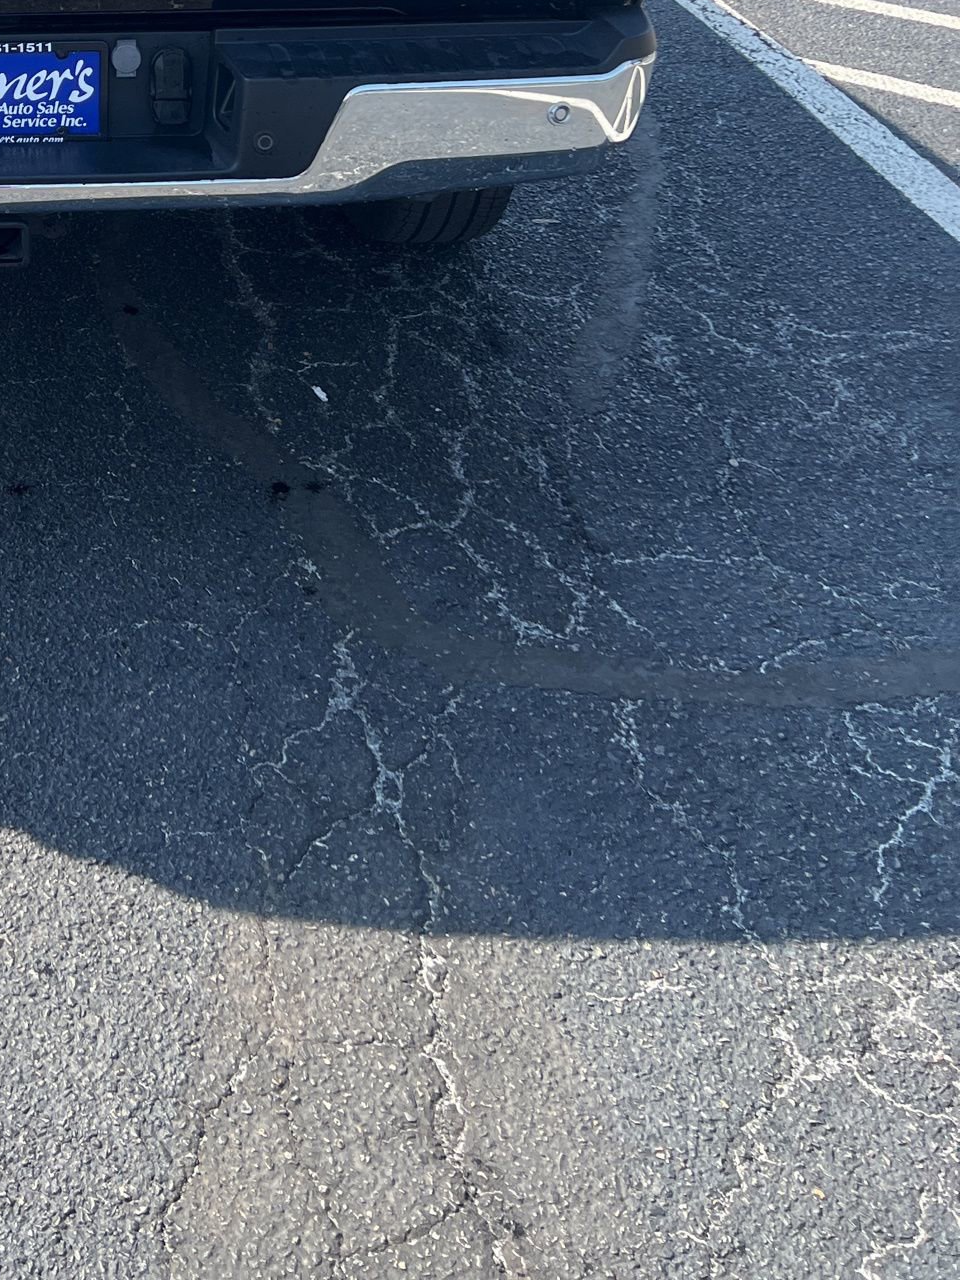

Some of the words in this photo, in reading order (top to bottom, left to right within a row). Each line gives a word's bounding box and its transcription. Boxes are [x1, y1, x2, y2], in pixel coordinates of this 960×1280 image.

[36, 101, 75, 114] Sales
[2, 115, 57, 128] Service
[60, 115, 87, 127] Inc.
